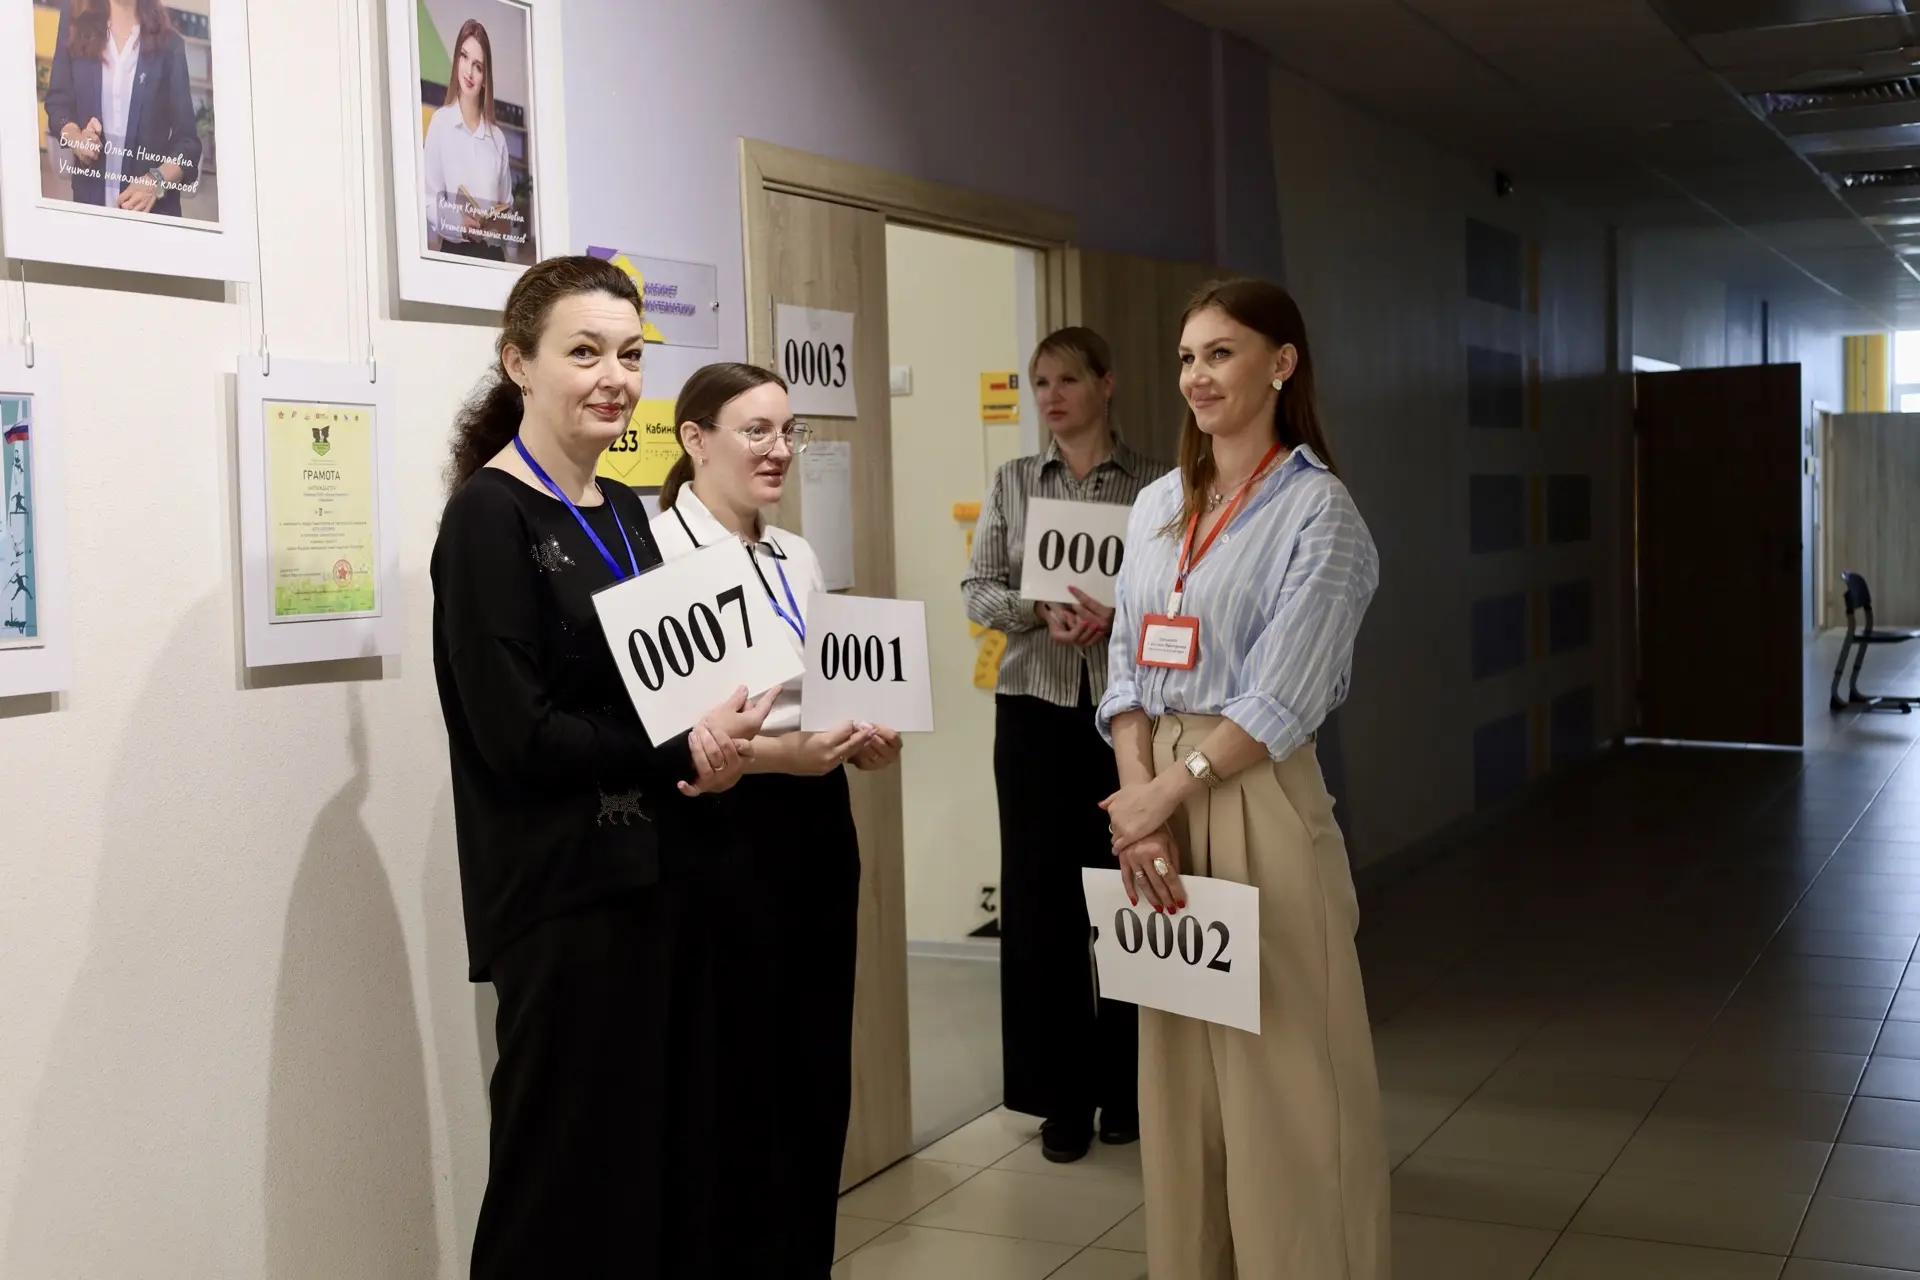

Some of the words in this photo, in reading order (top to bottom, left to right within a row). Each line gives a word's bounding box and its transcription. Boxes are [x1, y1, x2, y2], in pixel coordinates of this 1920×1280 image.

[60, 132, 101, 152] Бильбок
[104, 141, 134, 158] Ольга
[136, 145, 193, 168] Николаевна
[60, 158, 101, 178] Учитель
[104, 171, 158, 188] начальных
[160, 179, 199, 193] классов
[440, 218, 467, 233] Учитель
[469, 229, 502, 240] начальных
[502, 233, 527, 244] классов
[785, 338, 847, 388] 0003
[303, 469, 341, 481] ГРАМОТА
[628, 584, 753, 692] 0007
[820, 632, 907, 682] 0001
[1115, 907, 1232, 973] 0002
